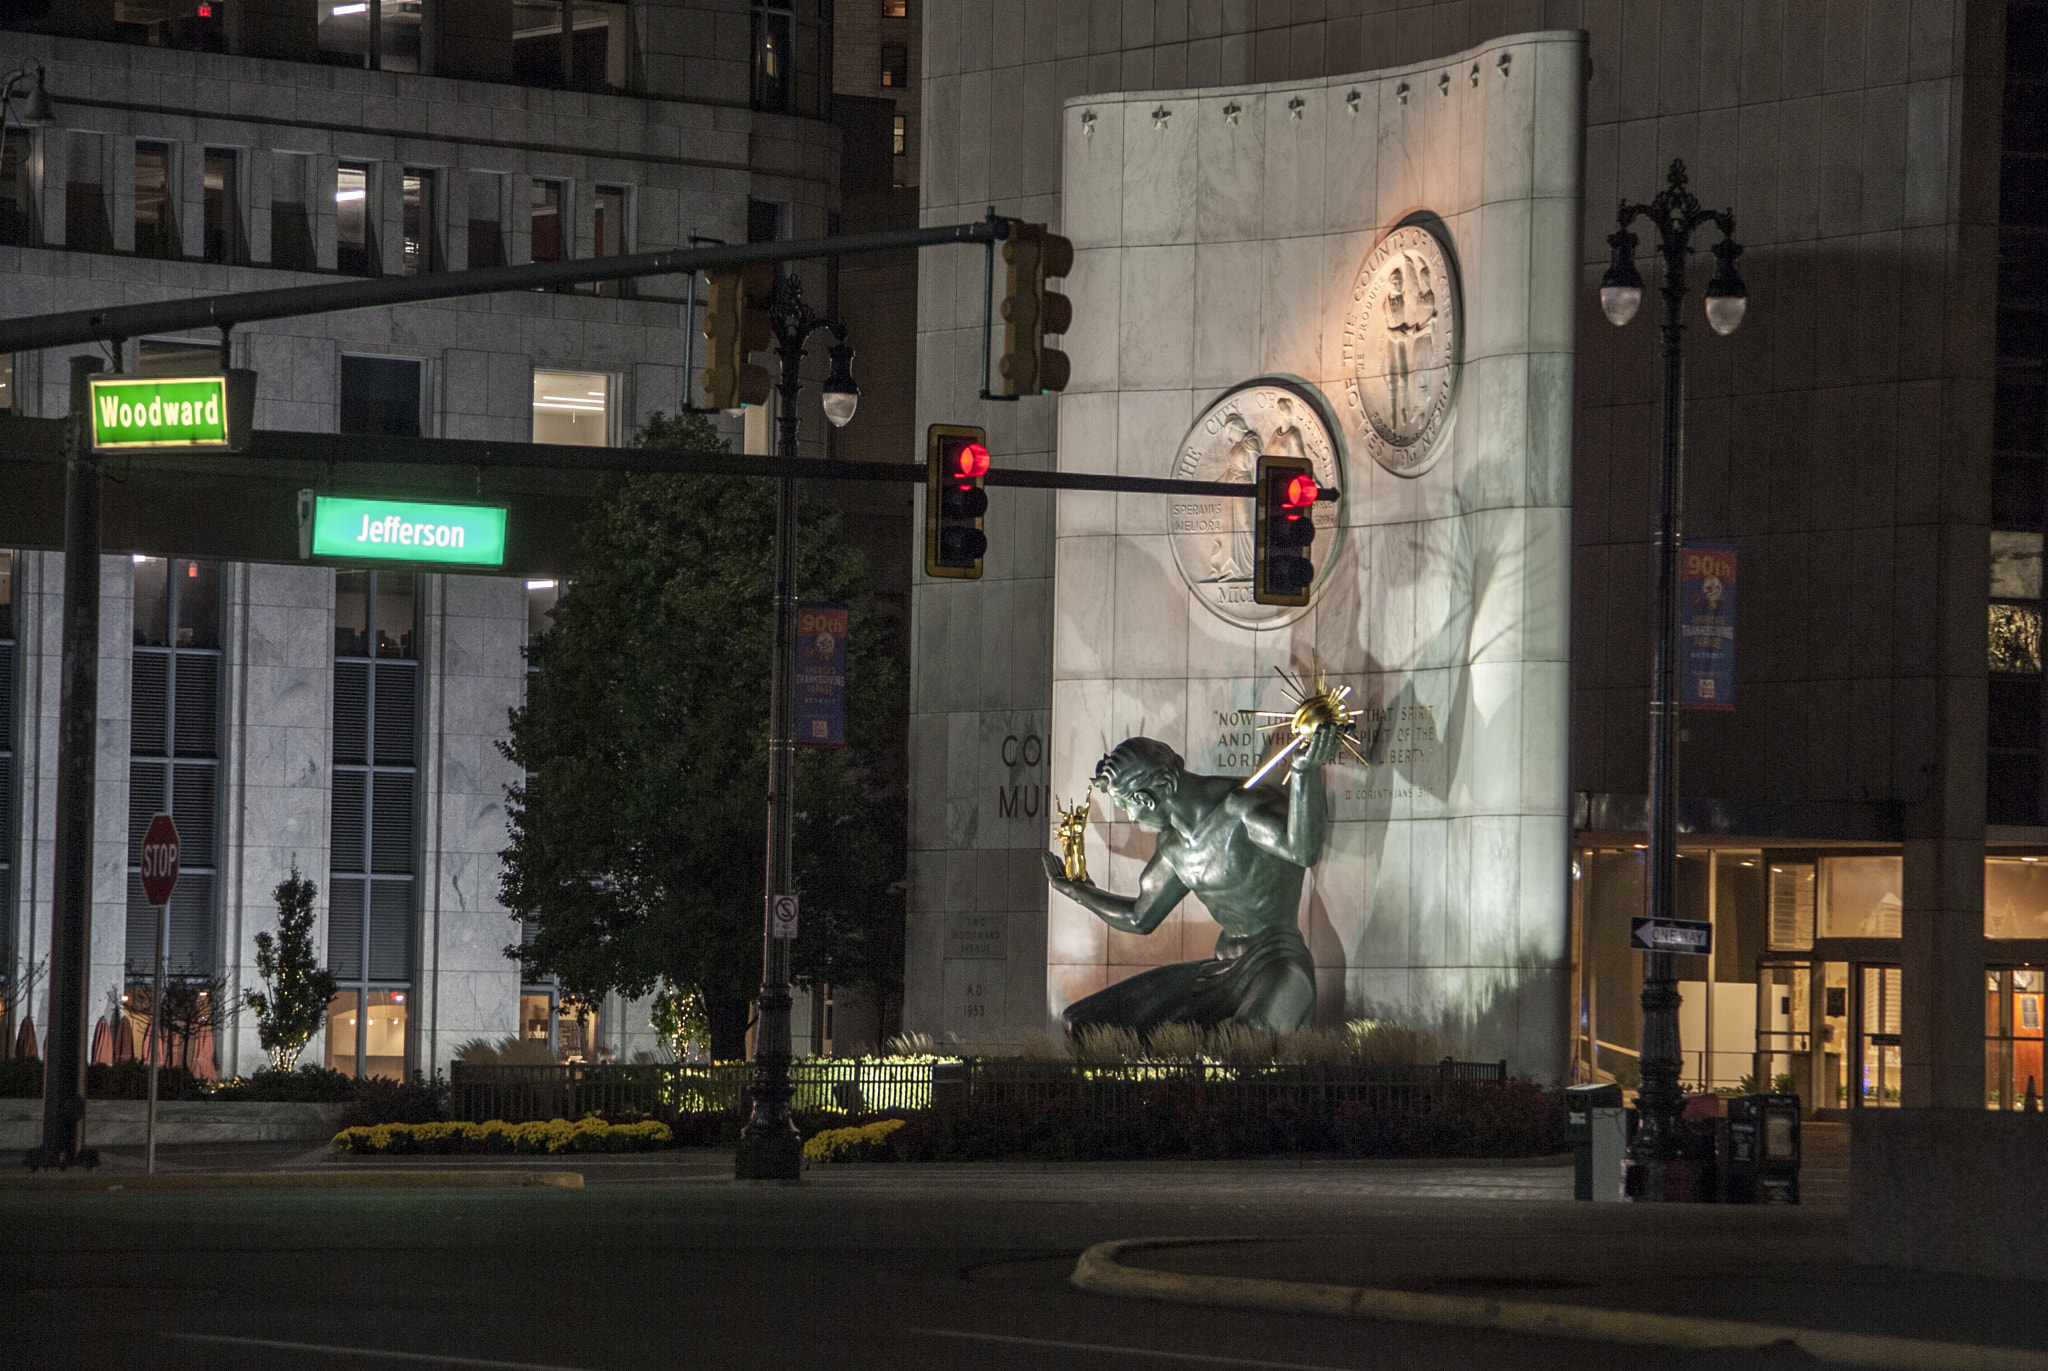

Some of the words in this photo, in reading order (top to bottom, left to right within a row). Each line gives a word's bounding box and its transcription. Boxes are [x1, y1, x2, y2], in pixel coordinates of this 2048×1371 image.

[1354, 229, 1408, 302] COUNTY
[1411, 230, 1428, 247] OF
[99, 393, 219, 428] Woodward
[1206, 398, 1242, 435] CITY
[1255, 391, 1277, 408] OF
[356, 513, 465, 548] Jefferson
[1175, 520, 1221, 532] MELIORA
[1688, 555, 1731, 577] 90th
[802, 614, 843, 634] 90th
[1364, 707, 1394, 722] THAT
[1401, 705, 1434, 721] SPIRIT
[1218, 733, 1252, 747] AND
[1397, 727, 1411, 742] OF
[1416, 726, 1434, 741] THE
[1218, 753, 1263, 768] LORD
[1355, 787, 1412, 800] CORINTHIANS
[143, 844, 178, 878] STOP
[1652, 928, 1677, 941] ONE
